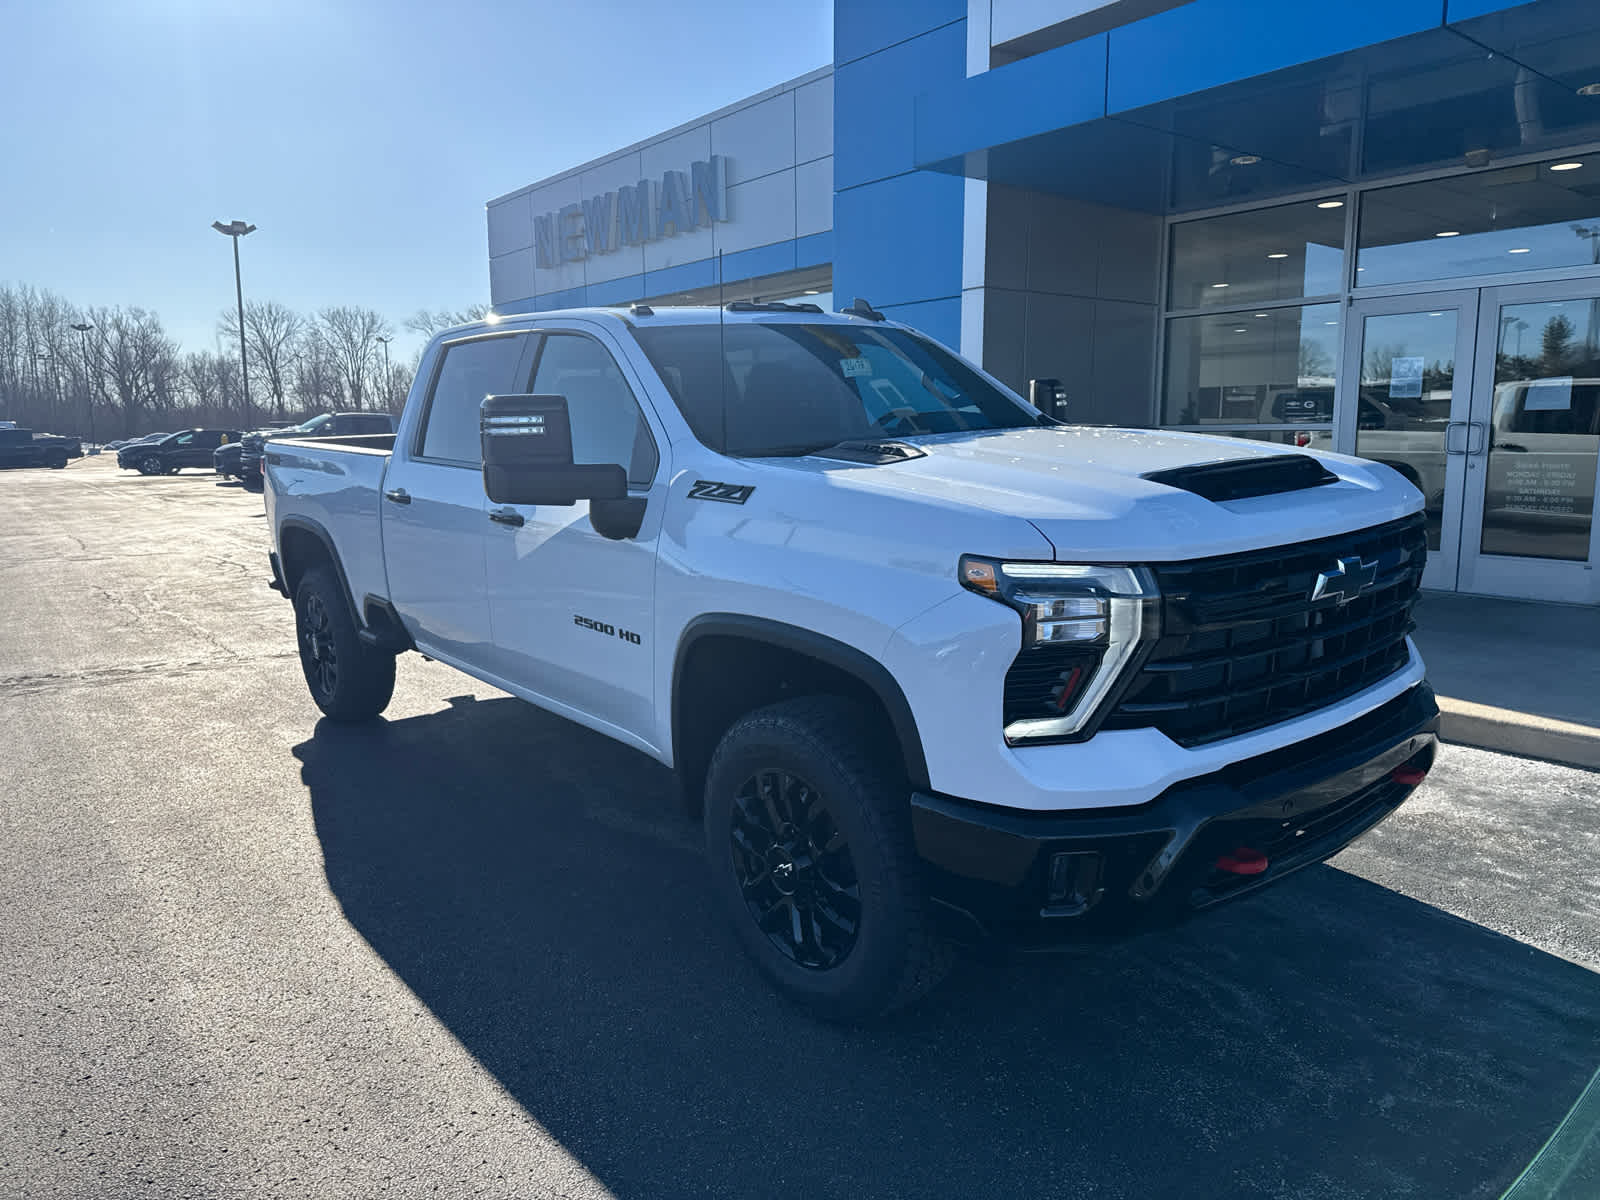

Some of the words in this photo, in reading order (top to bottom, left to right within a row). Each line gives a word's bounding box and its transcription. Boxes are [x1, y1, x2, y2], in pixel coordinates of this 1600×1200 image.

[534, 154, 729, 269] NEWMAN
[686, 479, 756, 505] Z71
[573, 614, 614, 636] 2500
[618, 628, 641, 645] HD
